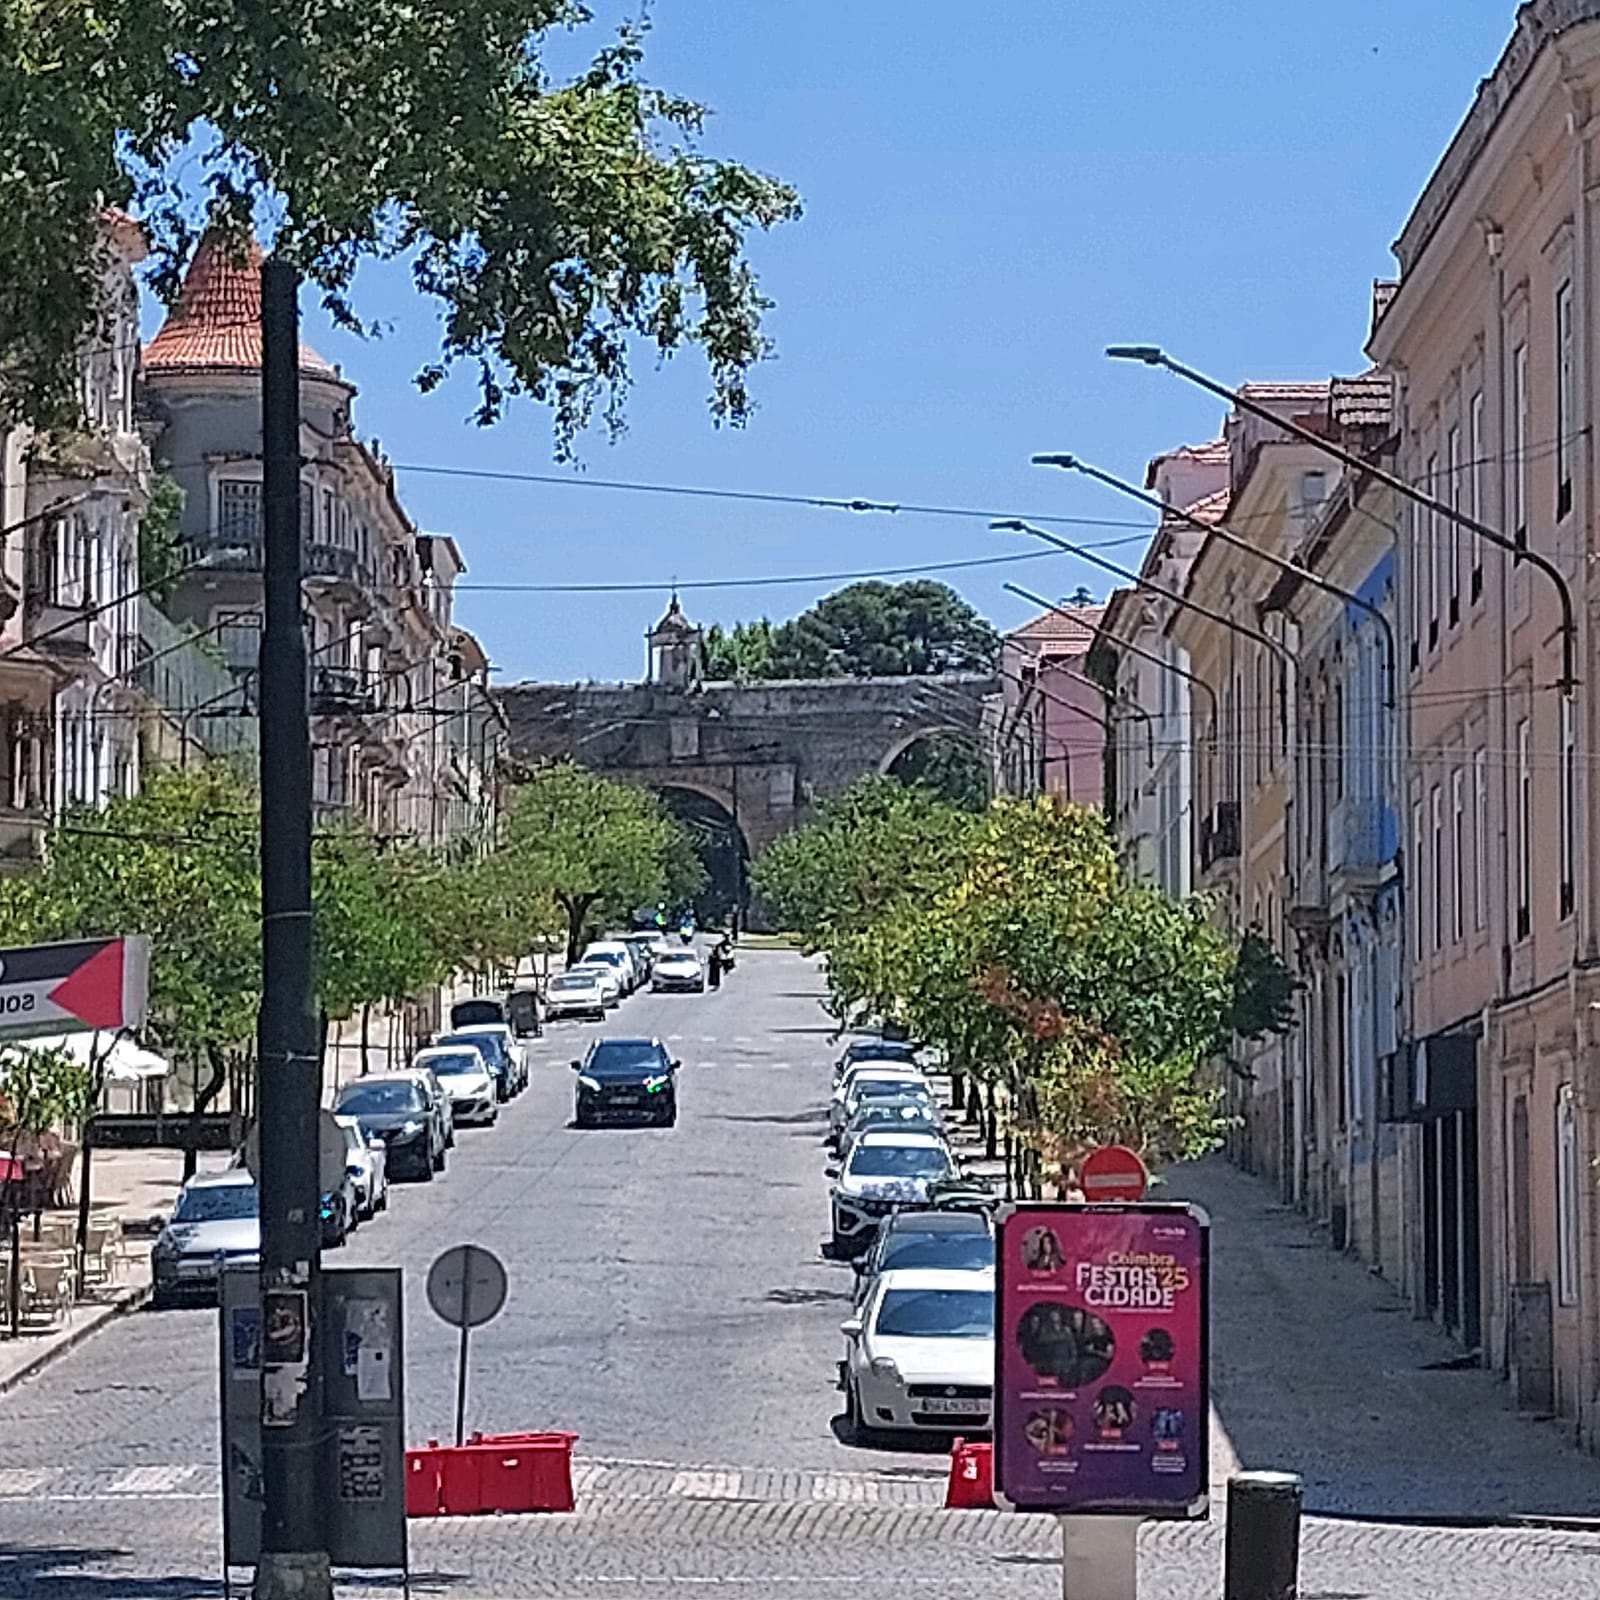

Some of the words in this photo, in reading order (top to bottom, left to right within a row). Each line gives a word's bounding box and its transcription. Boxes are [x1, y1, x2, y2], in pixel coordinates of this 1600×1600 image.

[1108, 1251, 1175, 1265] Coimbra
[1076, 1262, 1157, 1287] FESTAS
[1085, 1286, 1175, 1307] CIDADE
